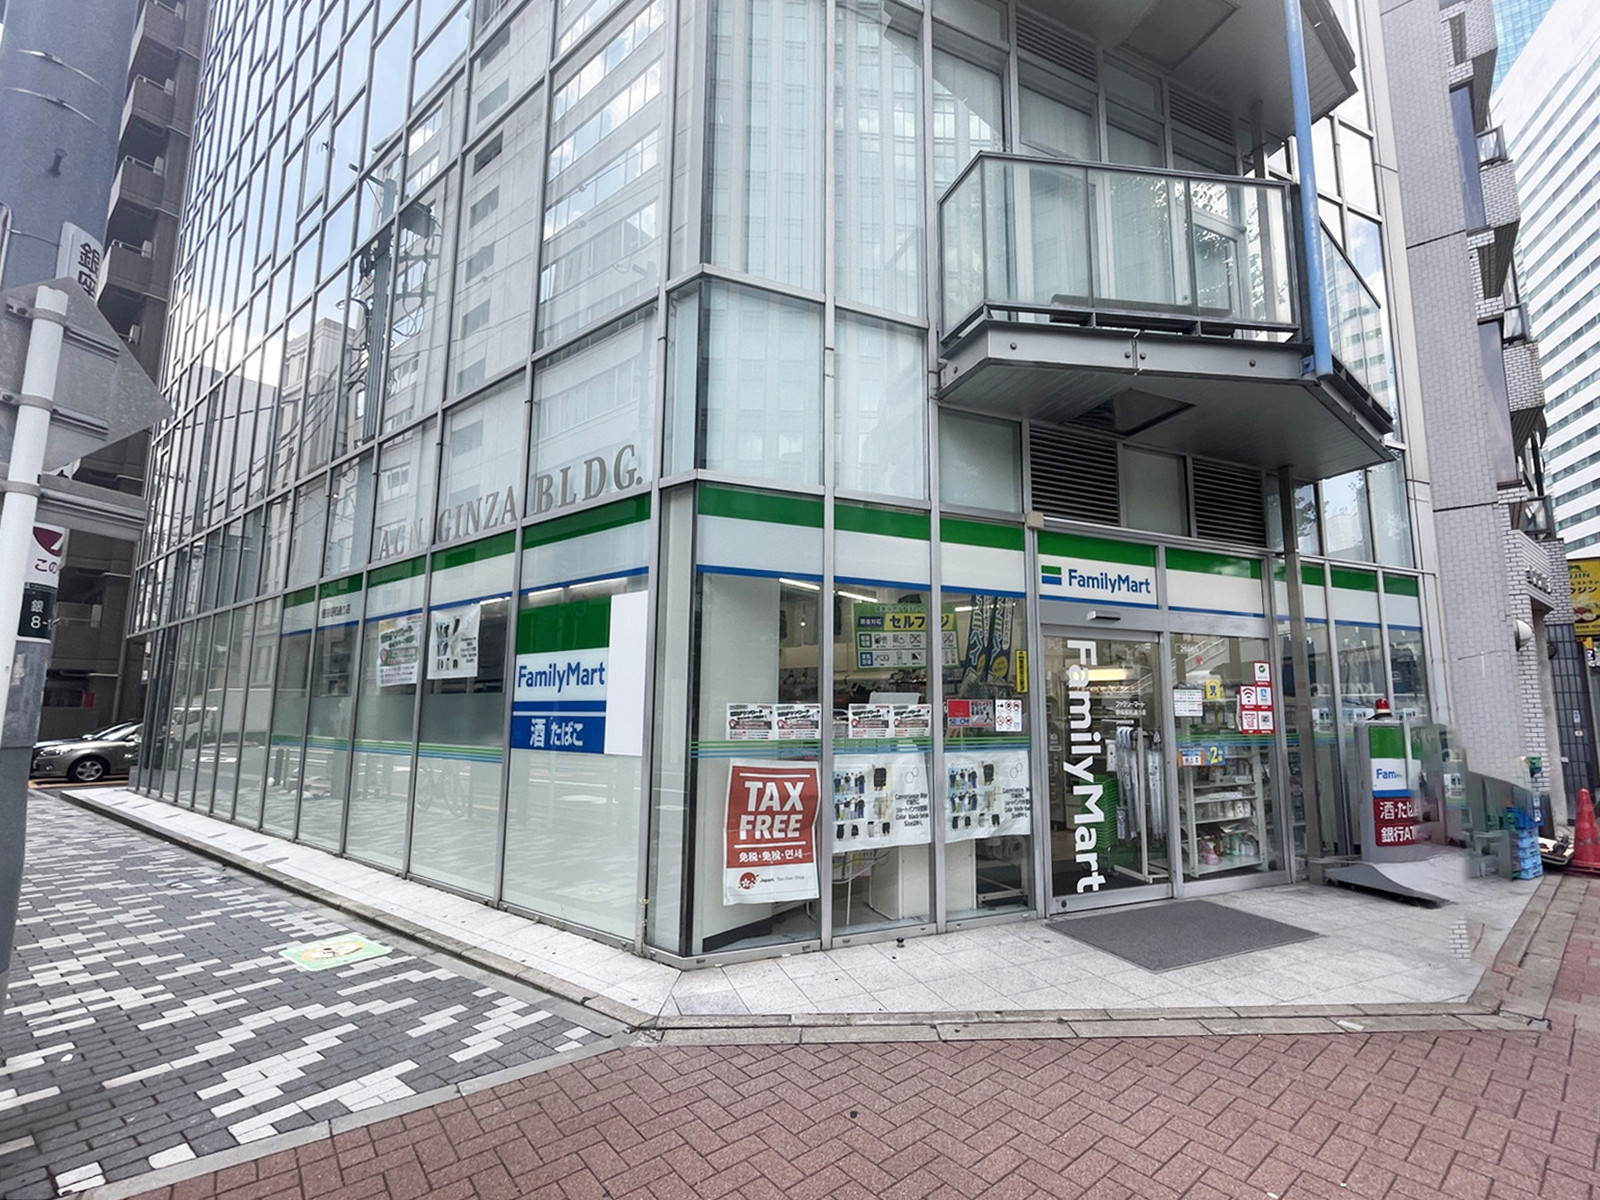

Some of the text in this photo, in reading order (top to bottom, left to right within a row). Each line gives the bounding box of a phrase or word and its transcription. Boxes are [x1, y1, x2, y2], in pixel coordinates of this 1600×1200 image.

[436, 485, 518, 543] GINZA
[535, 444, 643, 515] BLDG.
[1068, 568, 1151, 594] FamilyMart
[889, 615, 950, 629] セルフジ
[518, 661, 605, 693] FamilyMart
[529, 718, 584, 748] 酒 たばこ
[1064, 640, 1106, 893] FamilyMart
[744, 781, 805, 812] TAX
[739, 814, 803, 841] FREE
